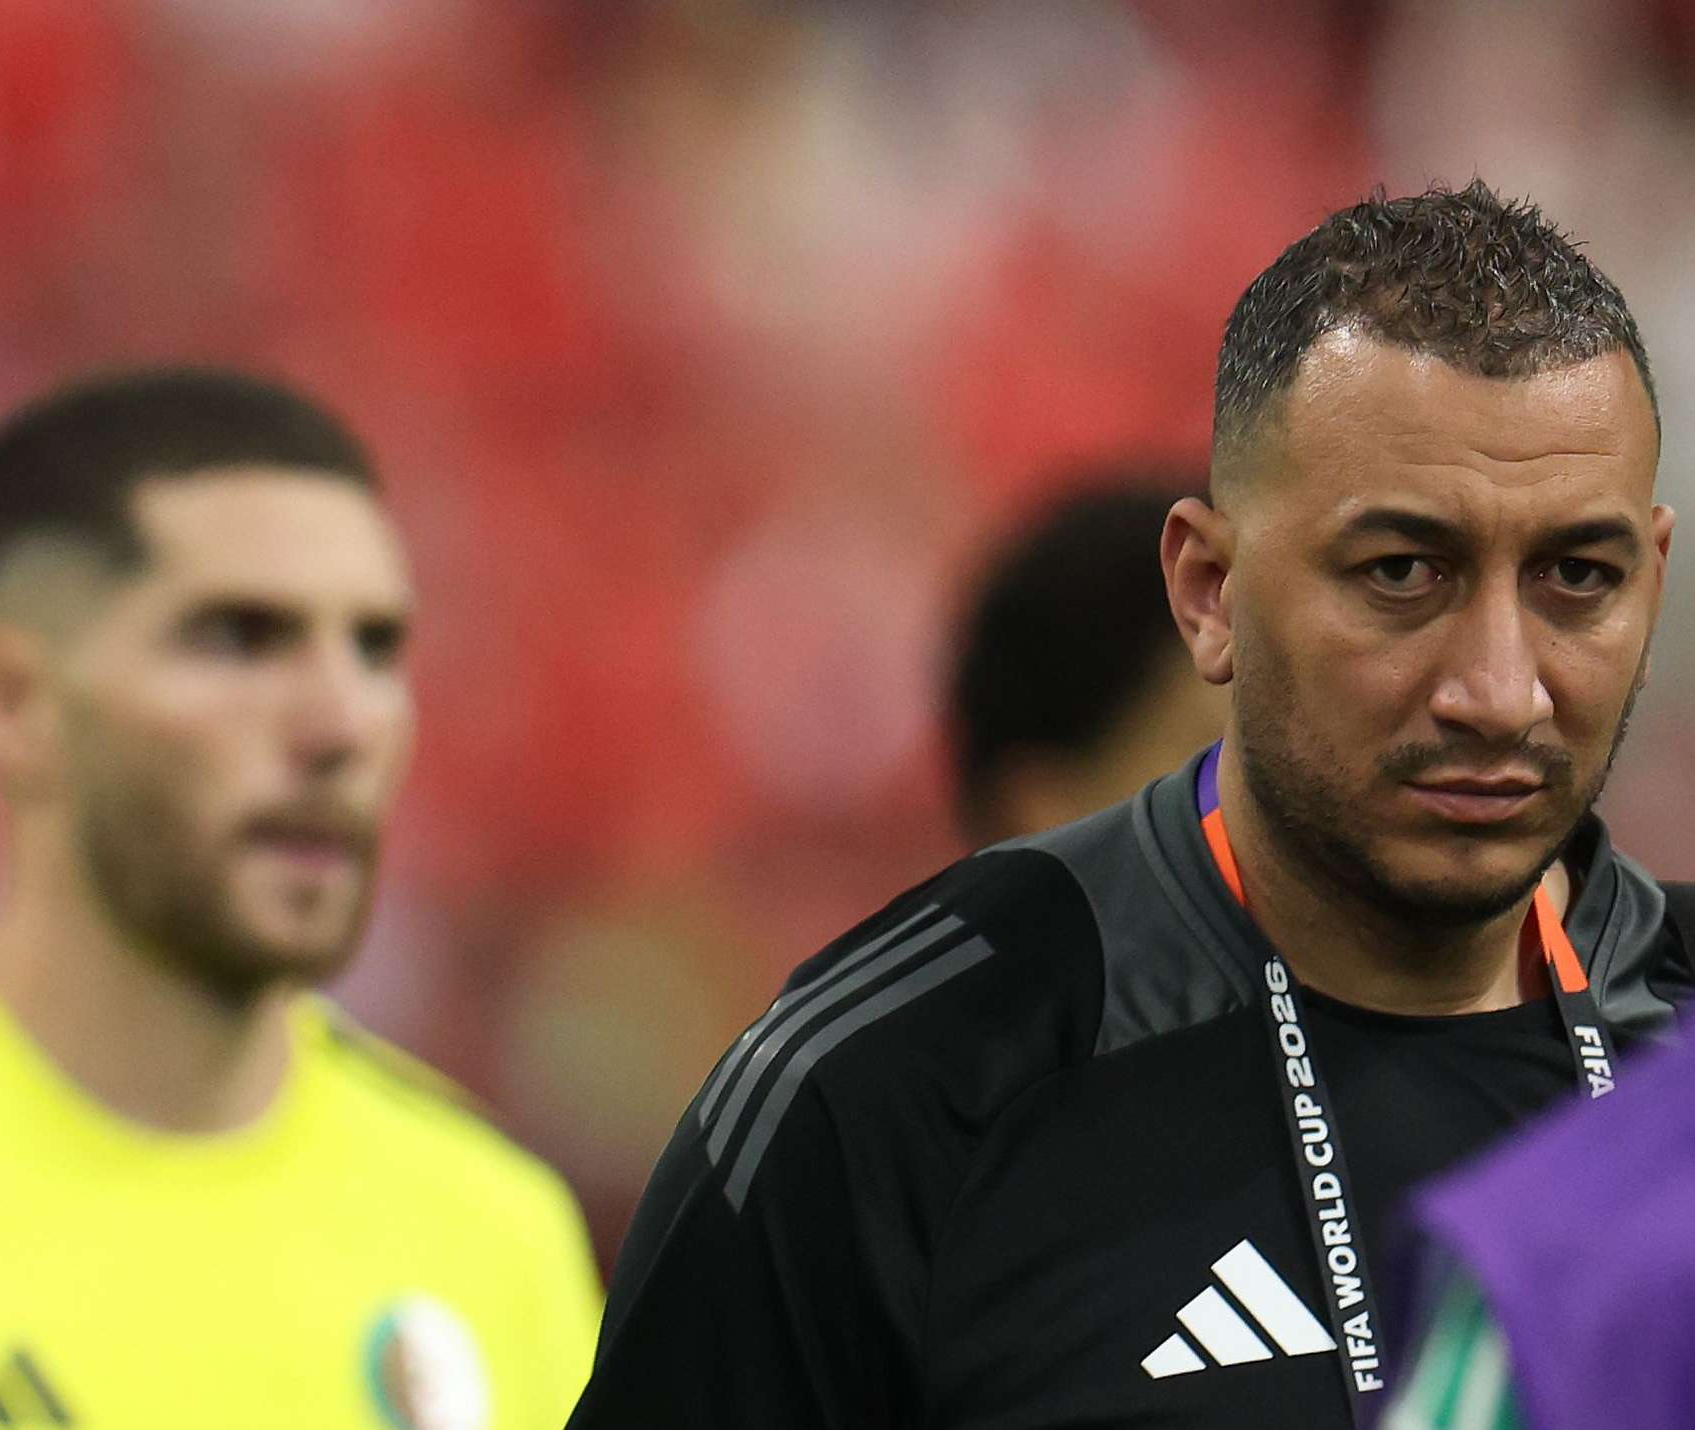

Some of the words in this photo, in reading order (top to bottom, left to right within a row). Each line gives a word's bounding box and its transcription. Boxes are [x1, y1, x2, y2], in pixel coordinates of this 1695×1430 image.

[1264, 960, 1315, 1088] 2026
[1574, 1025, 1615, 1100] FIFA
[1294, 1093, 1334, 1167] CUP
[1313, 1172, 1365, 1310] WORLD
[1343, 1311, 1384, 1392] FIFA
